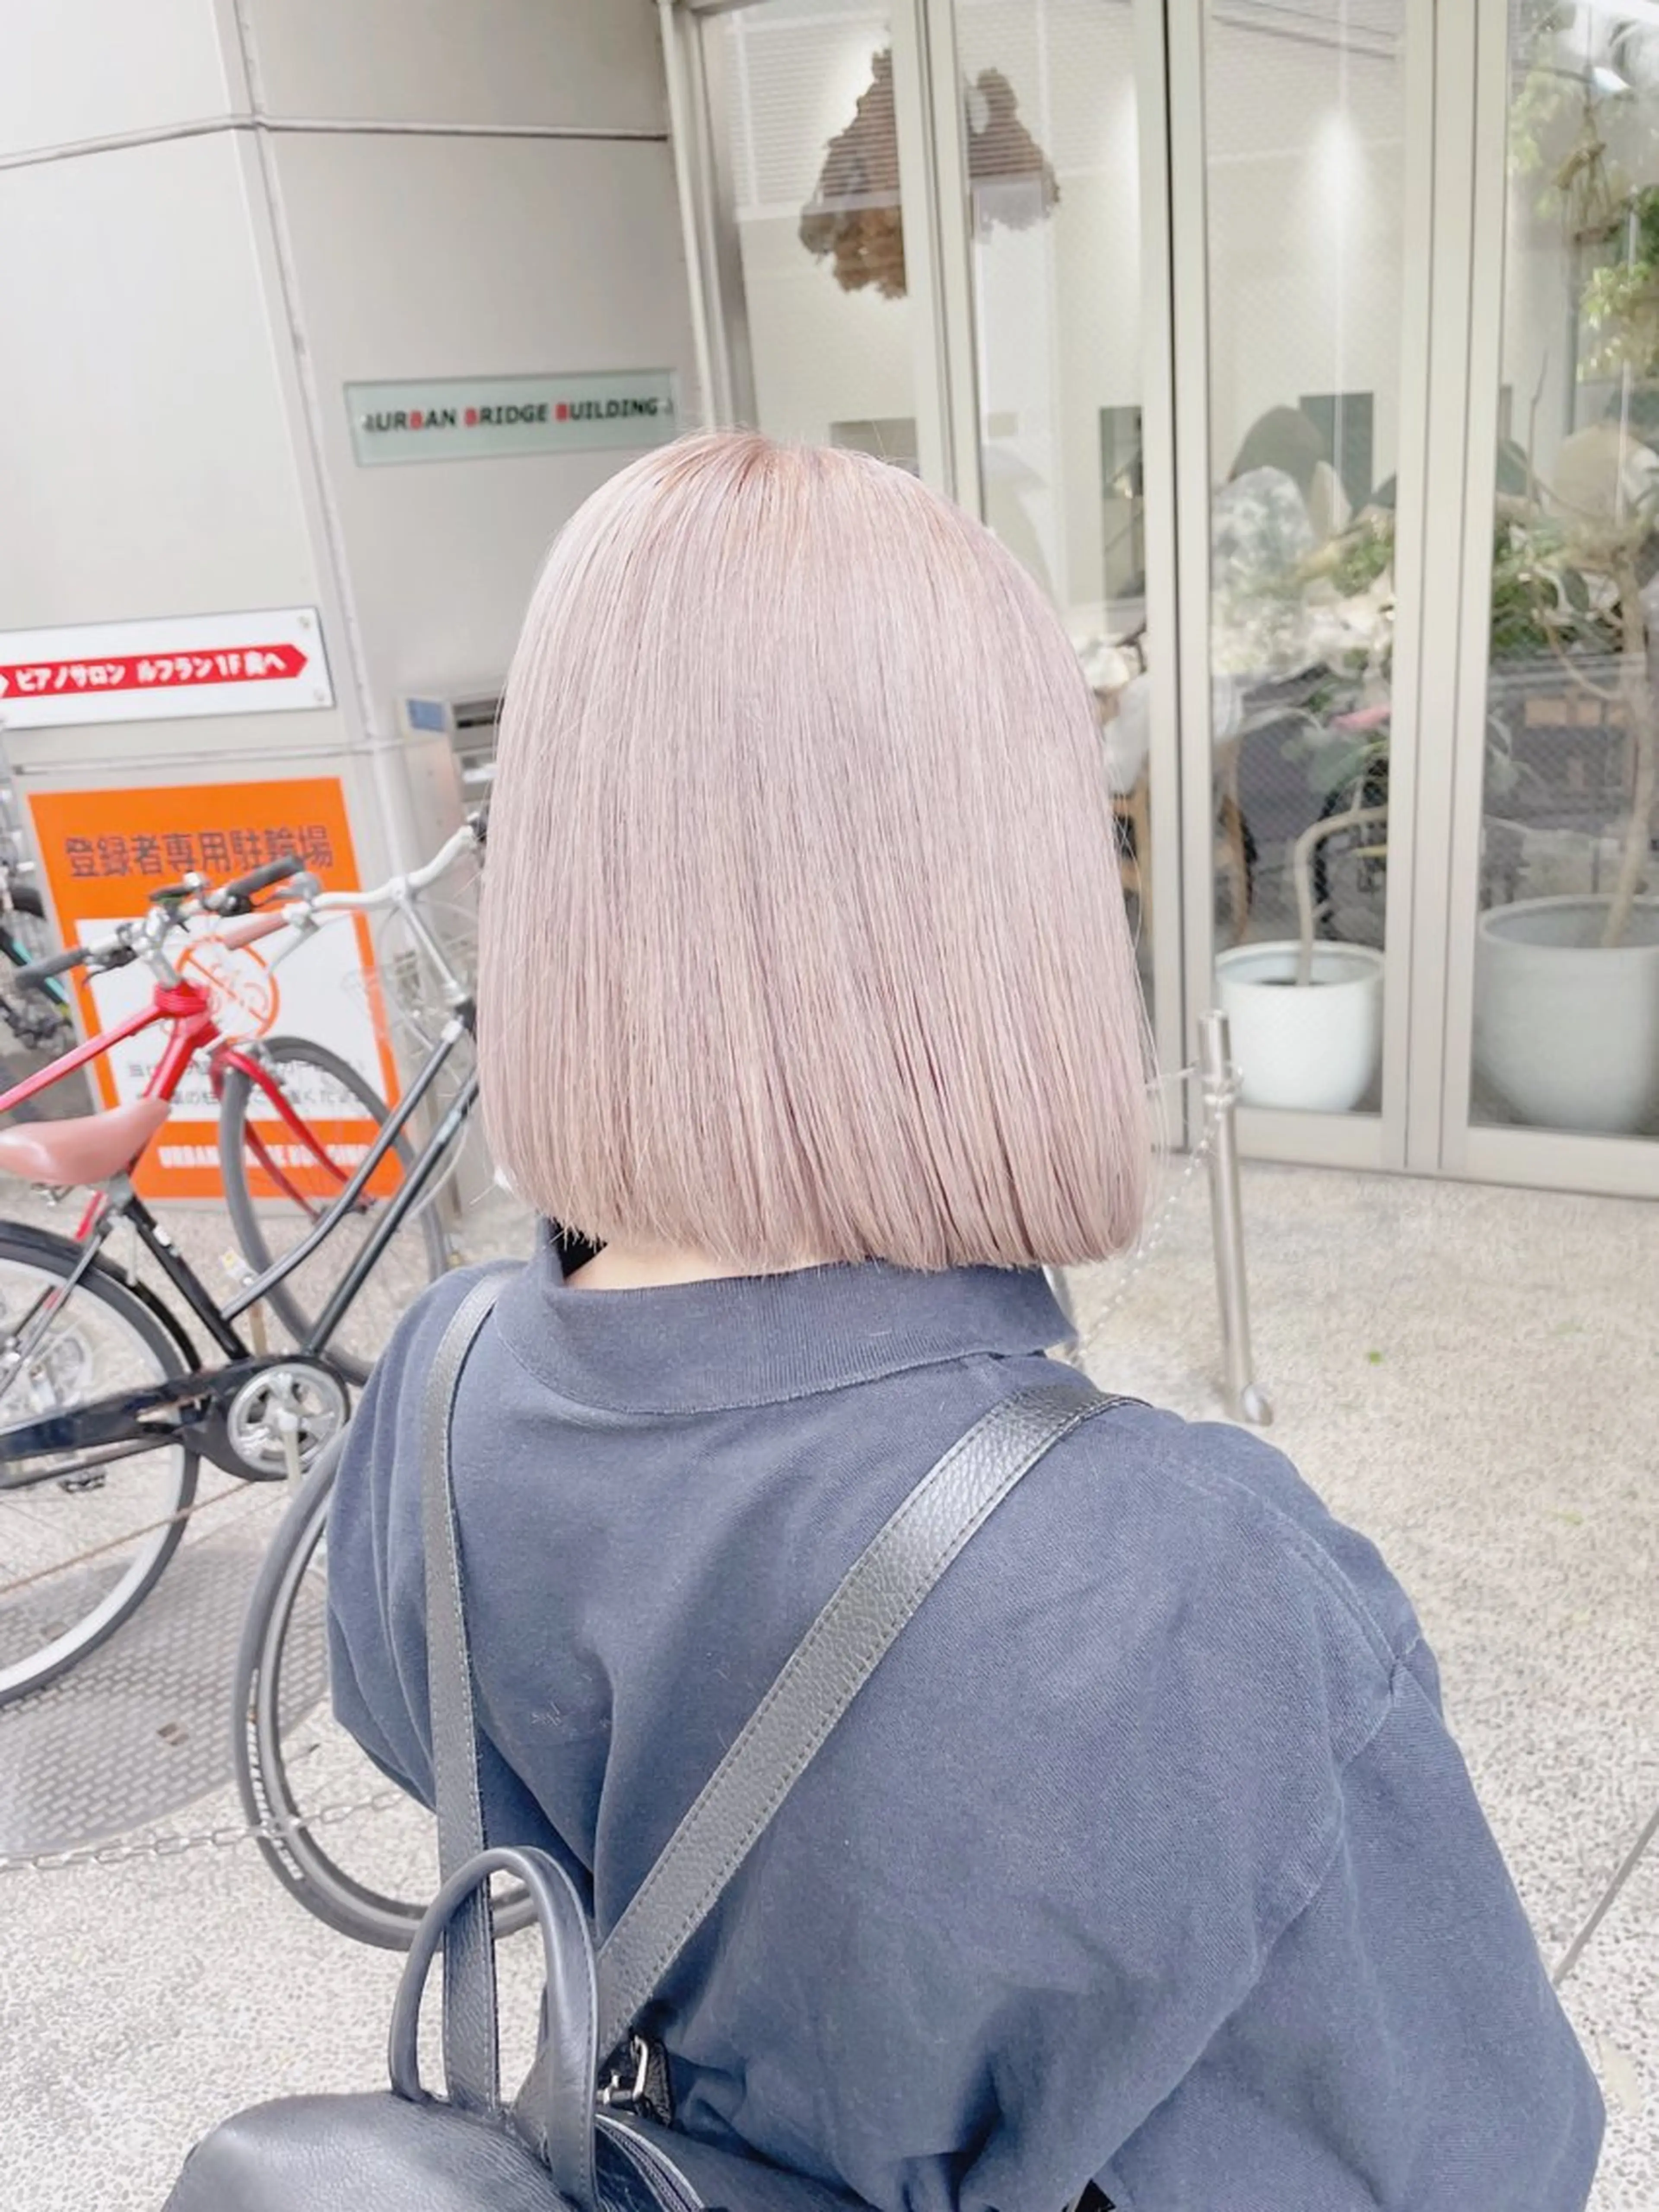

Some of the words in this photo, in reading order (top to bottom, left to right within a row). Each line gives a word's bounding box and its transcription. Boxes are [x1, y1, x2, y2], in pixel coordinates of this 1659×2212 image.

[375, 407, 456, 431] URBAN
[463, 402, 548, 427] BRIDGE
[555, 396, 658, 423] BUILDING
[15, 664, 126, 691] ピアノサロン
[65, 824, 334, 877] 登録者専用駐輪場
